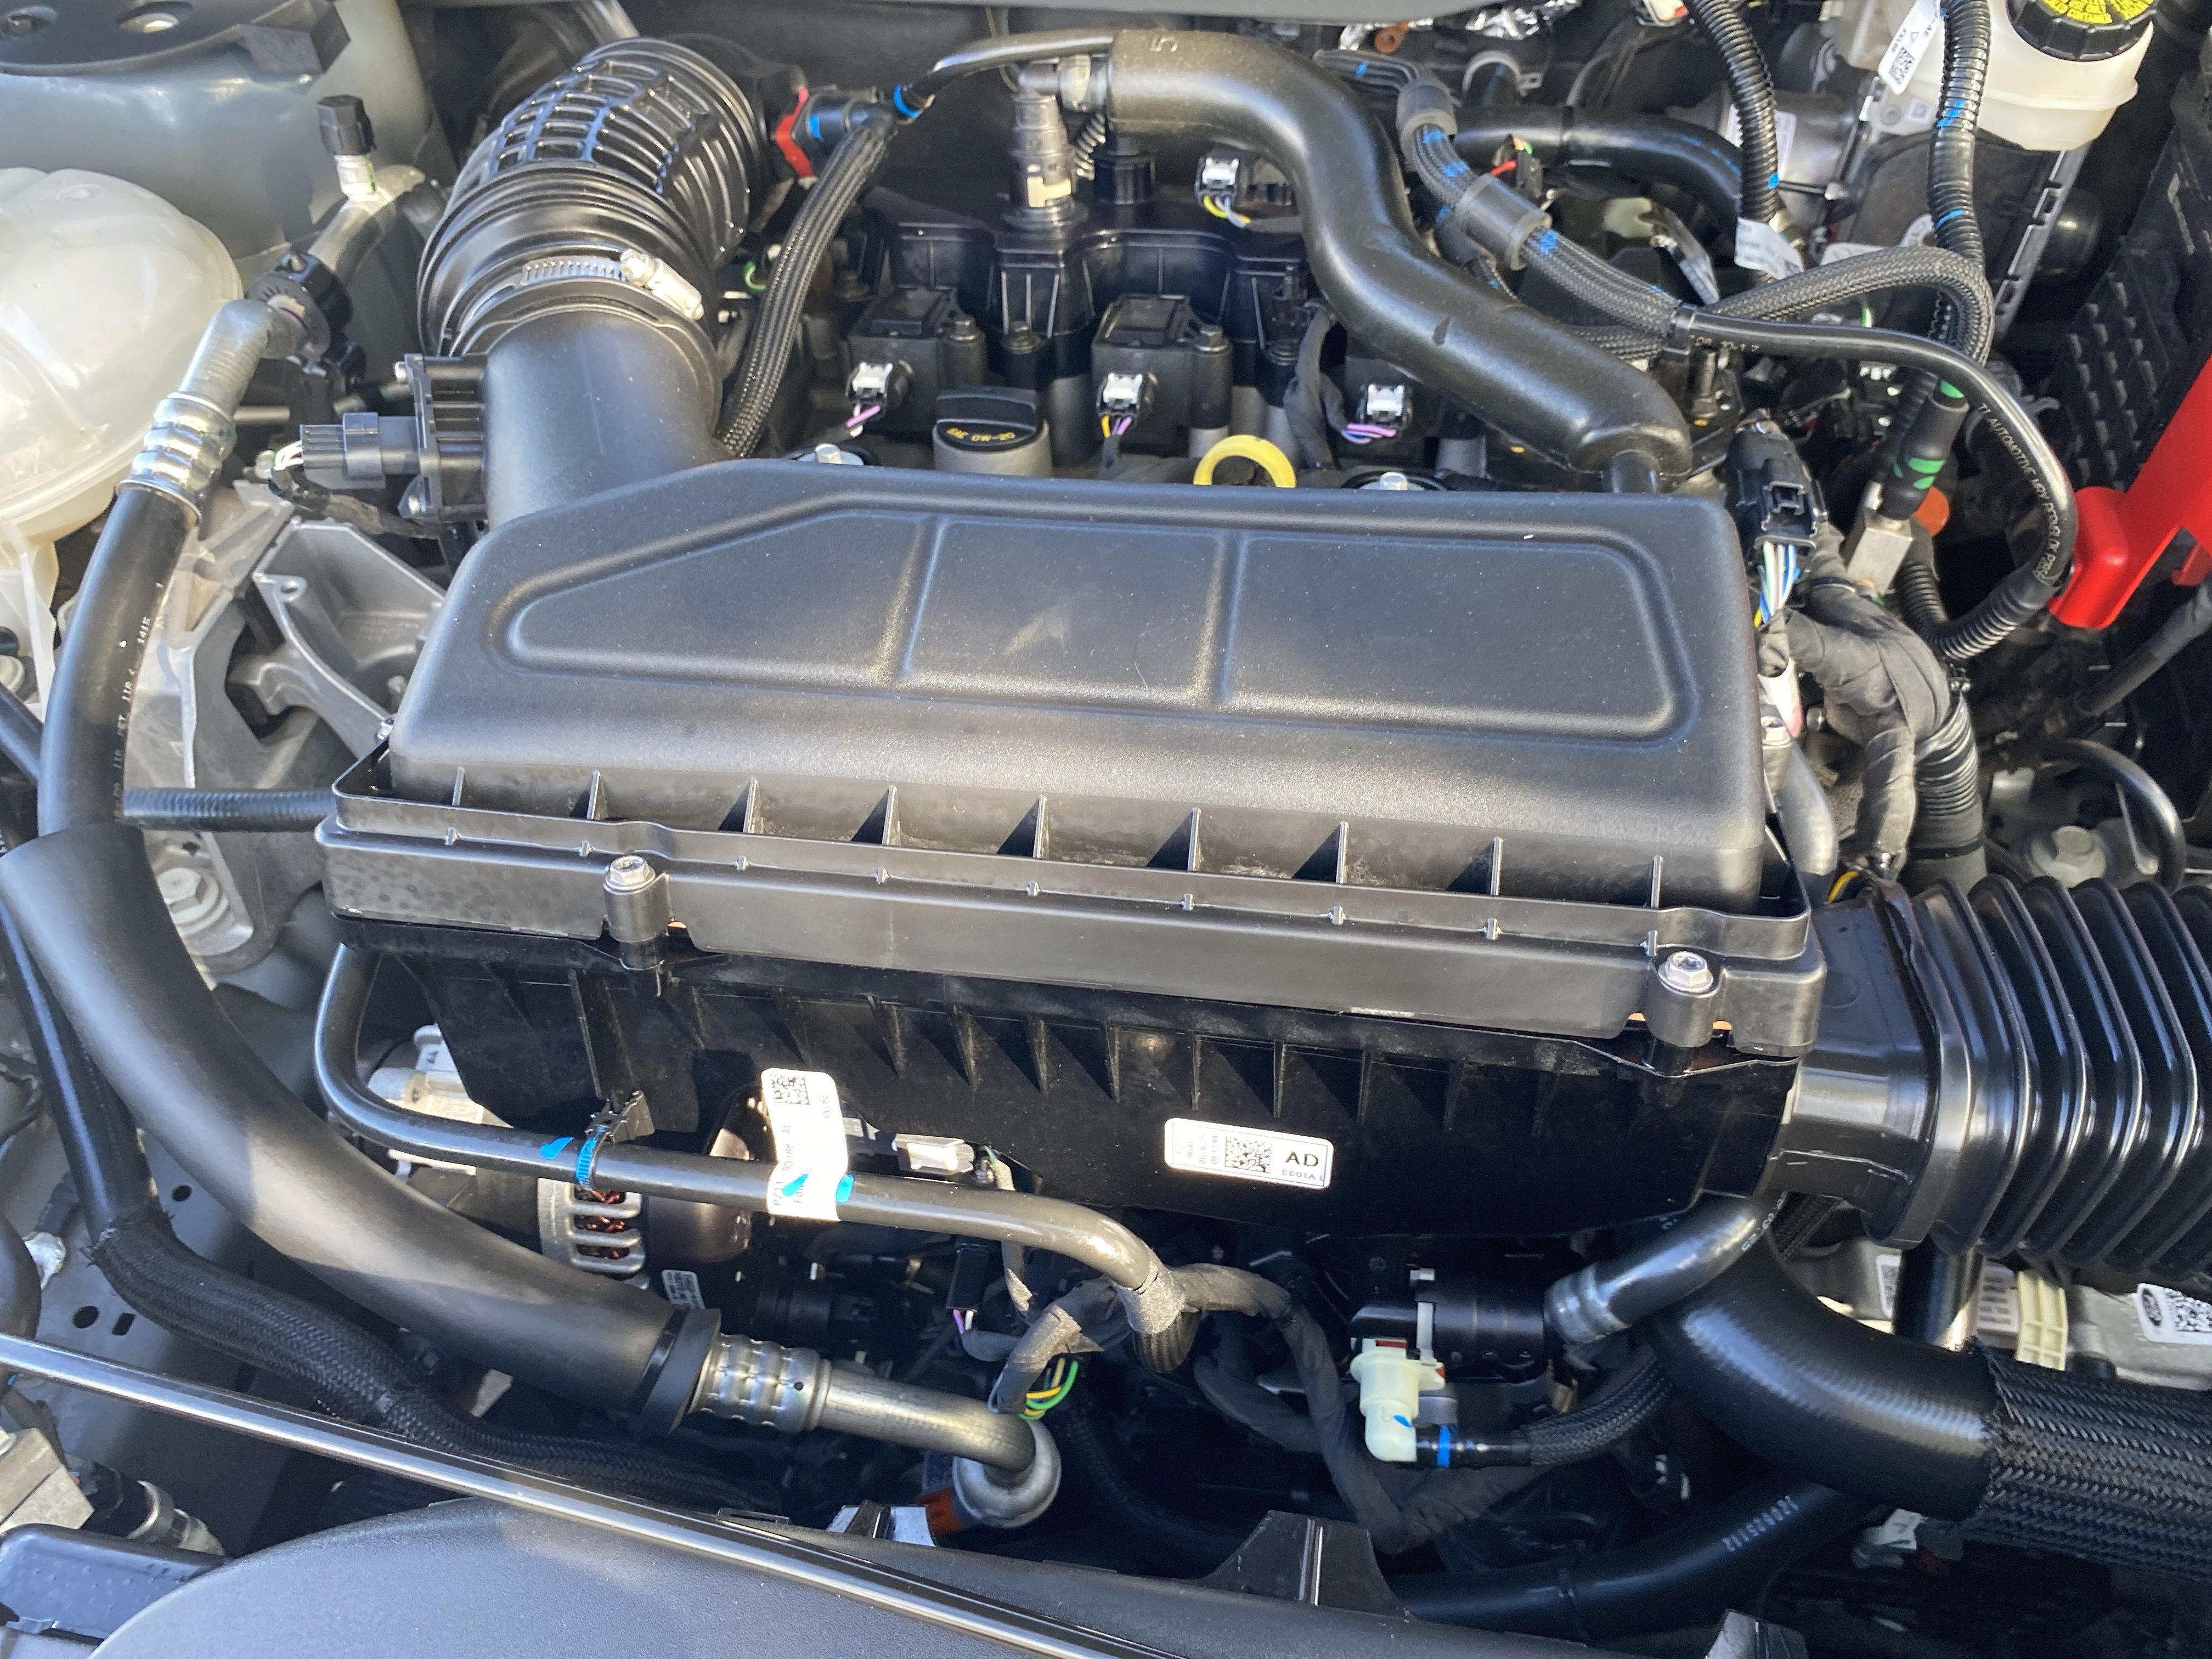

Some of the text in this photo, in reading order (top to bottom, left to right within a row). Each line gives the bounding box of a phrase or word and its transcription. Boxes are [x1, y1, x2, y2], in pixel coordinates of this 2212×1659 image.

[1988, 417, 2036, 476] AUTOMOTIVE
[1285, 1151, 1319, 1167] AD
[1281, 1169, 1316, 1180] EE01A
